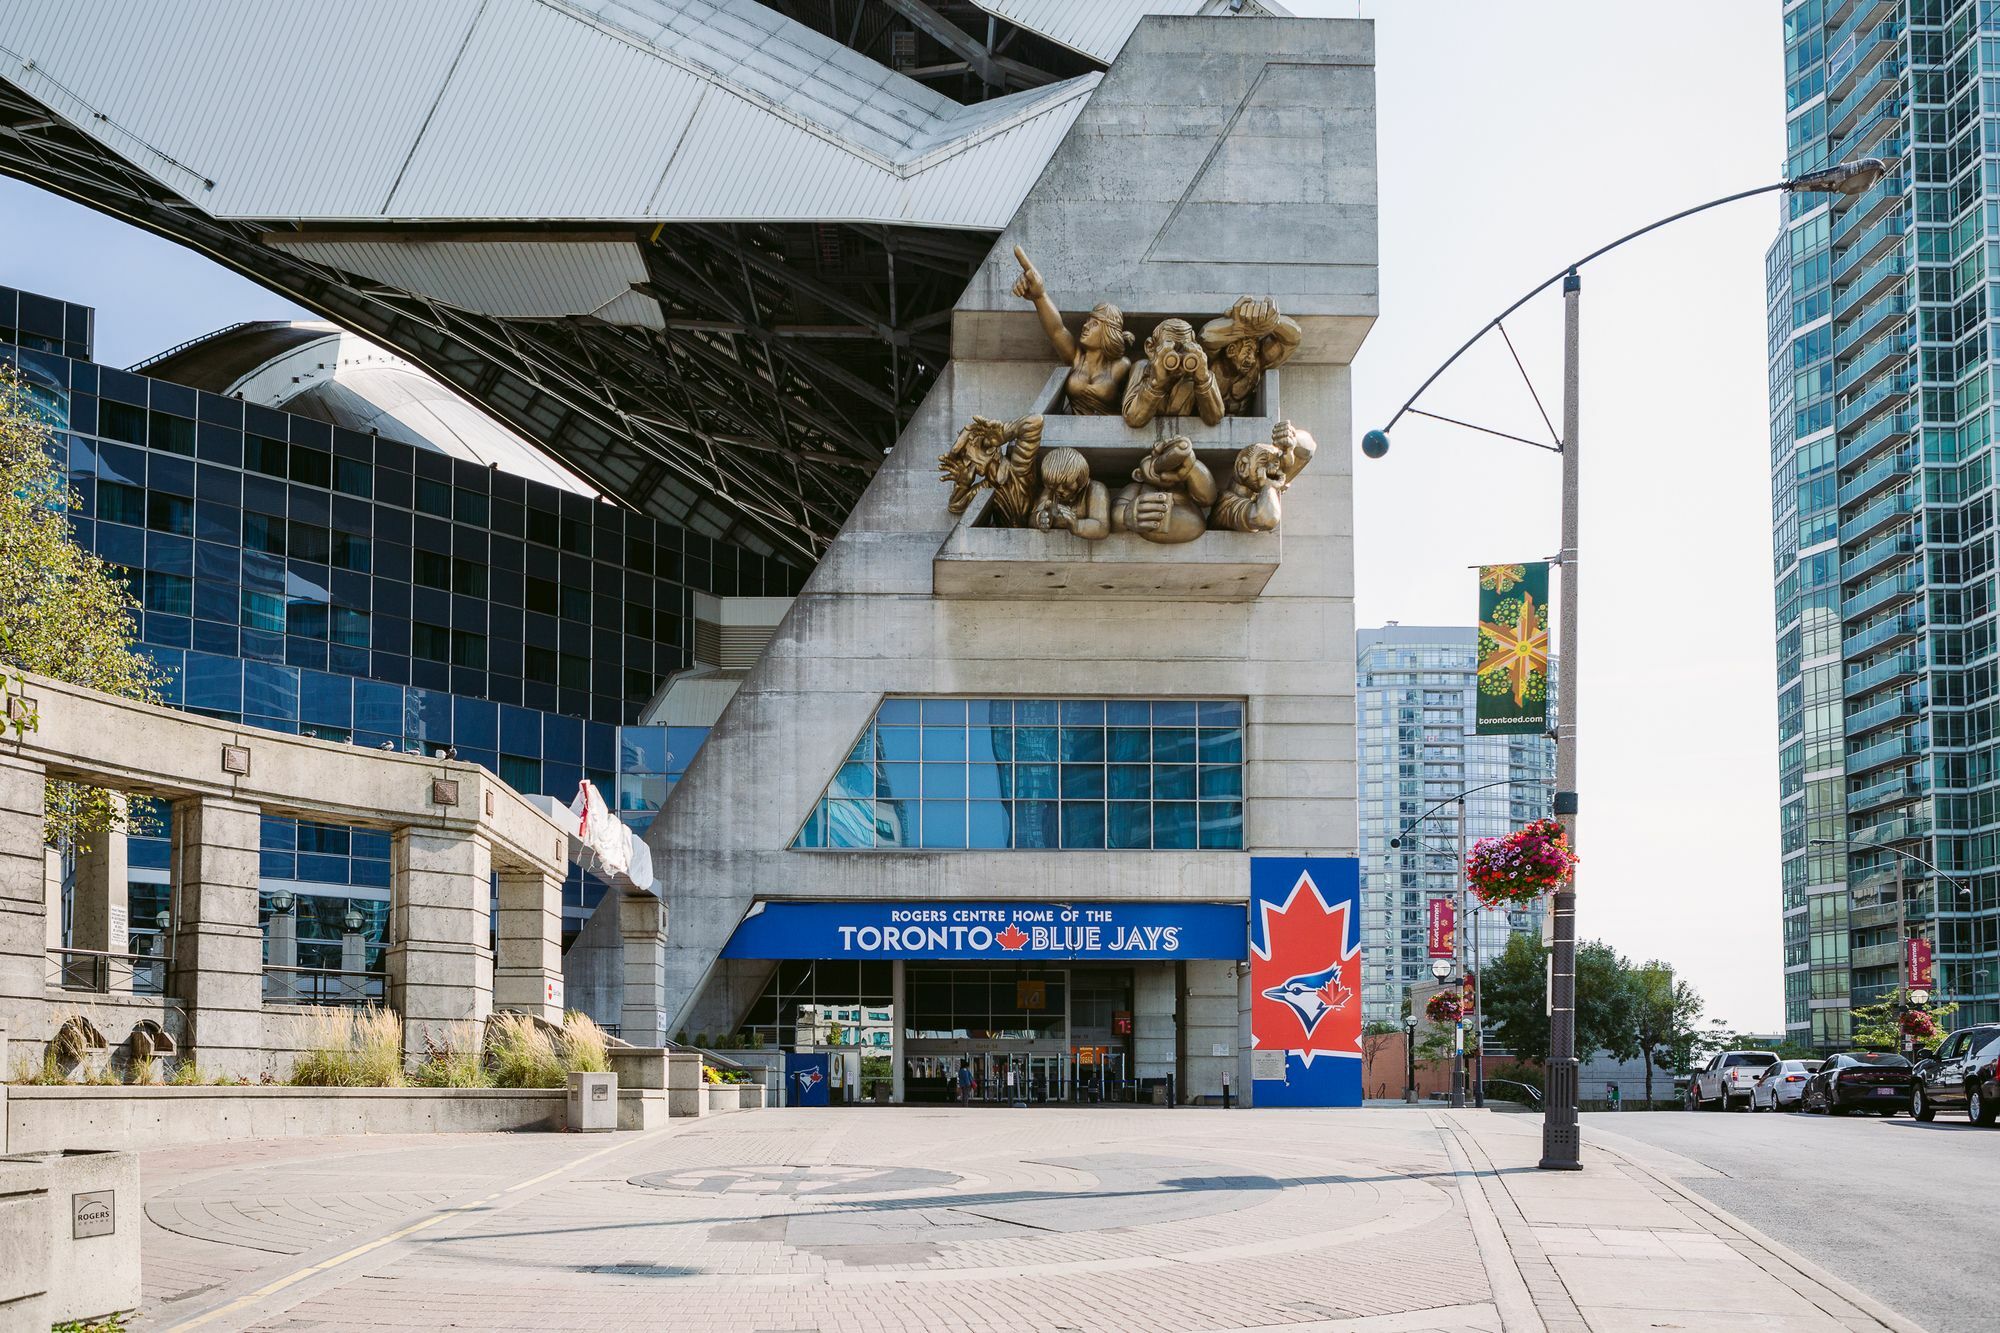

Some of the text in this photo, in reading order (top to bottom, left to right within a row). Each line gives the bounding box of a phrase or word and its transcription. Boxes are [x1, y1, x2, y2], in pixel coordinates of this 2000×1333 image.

[1479, 716, 1543, 724] torontoed.com
[891, 910, 1113, 922] ROGERS CENTRE HOME OF THE
[838, 925, 993, 952] TORONTO
[1031, 926, 1102, 951] BLUE
[78, 1211, 110, 1221] ROGERS
